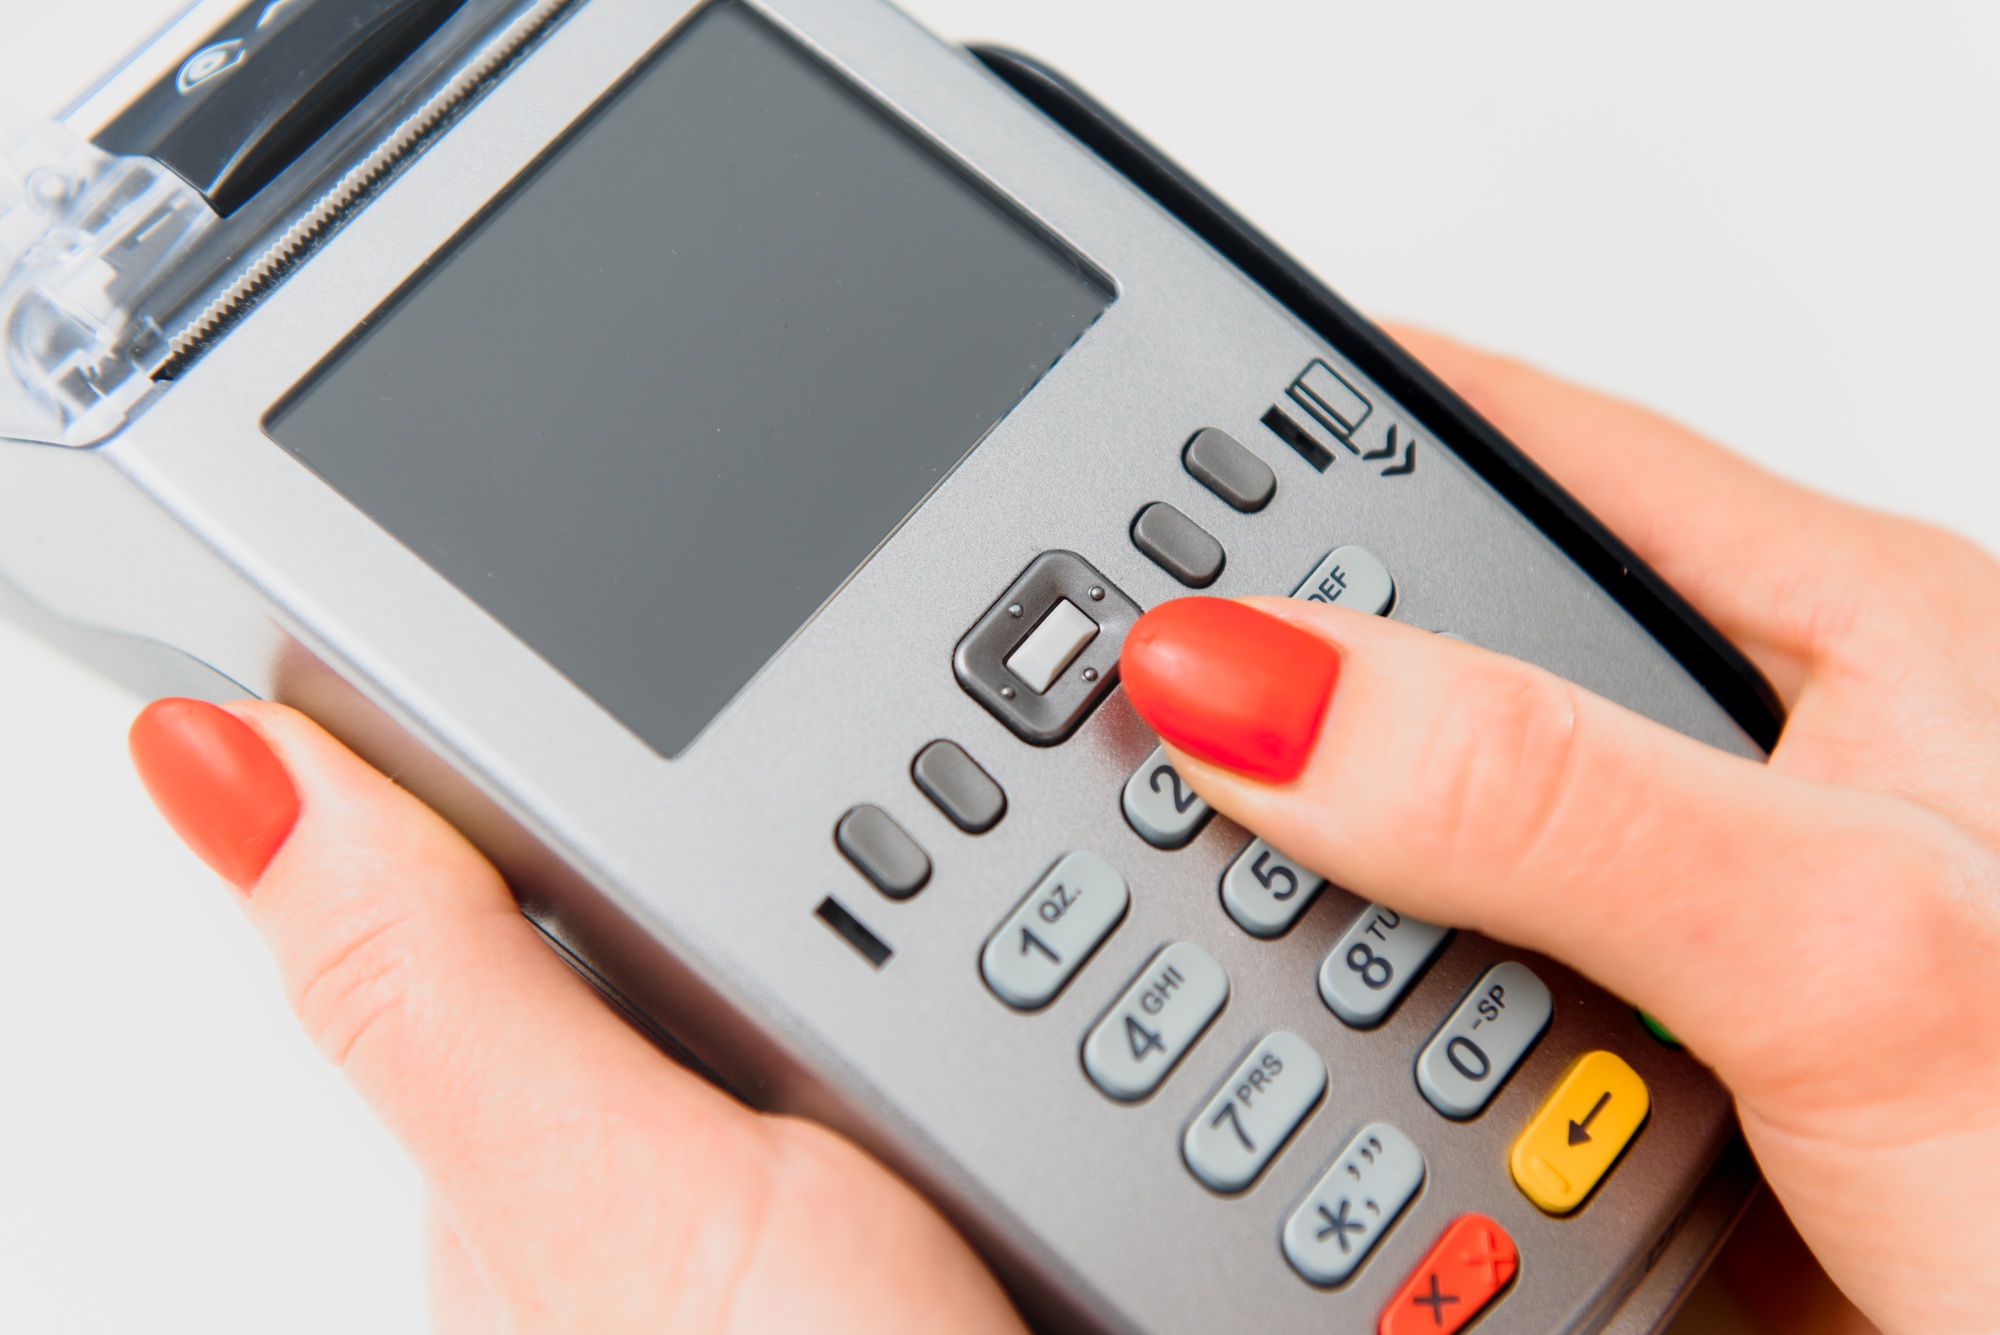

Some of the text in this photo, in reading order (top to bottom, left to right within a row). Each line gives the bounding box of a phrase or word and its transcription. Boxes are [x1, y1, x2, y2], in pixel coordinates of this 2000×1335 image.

[1150, 764, 1199, 814] 2
[1251, 850, 1299, 901] 5
[1020, 928, 1060, 963] 1
[1346, 943, 1394, 991] 8
[1125, 966, 1185, 1060] 4 GHI
[1447, 1036, 1491, 1083] 0
[1210, 1054, 1283, 1153] 7 PRS
